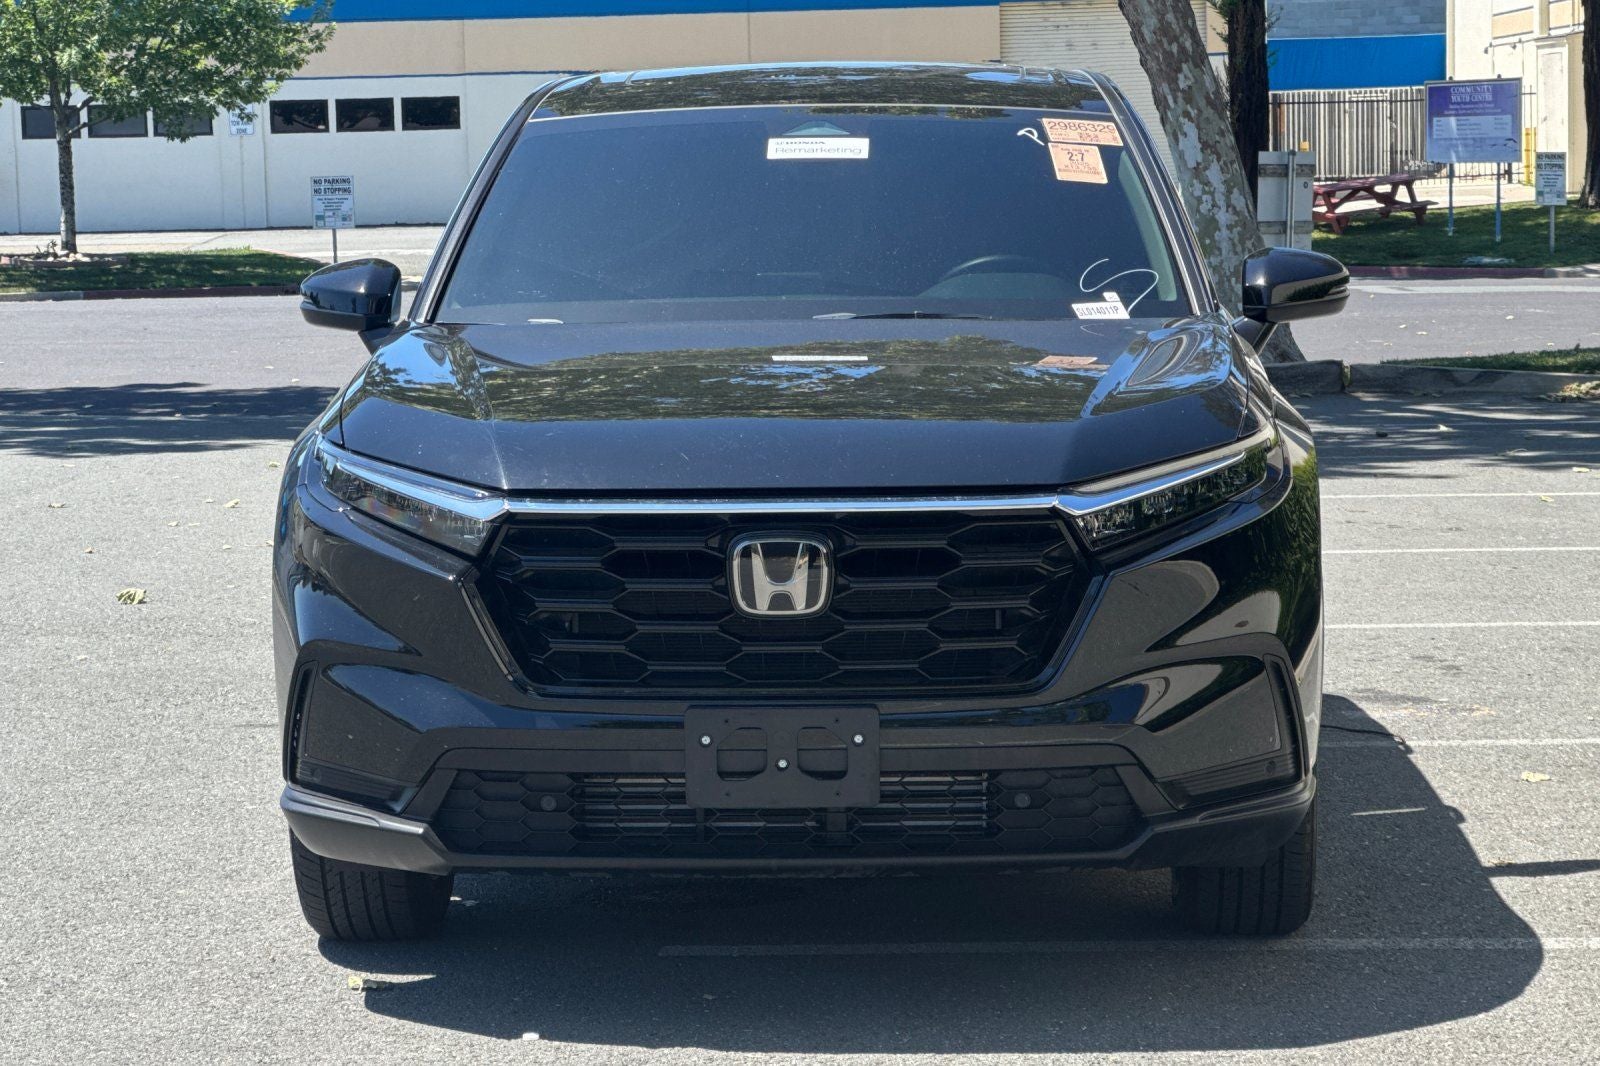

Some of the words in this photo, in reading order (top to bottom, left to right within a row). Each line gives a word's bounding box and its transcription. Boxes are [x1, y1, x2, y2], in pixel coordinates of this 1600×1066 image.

[1450, 84, 1493, 94] COMMUNITY
[1047, 121, 1117, 134] 2986329
[775, 147, 862, 156] Remarketing
[323, 177, 351, 185] PARKING
[323, 186, 352, 194] STOPPING
